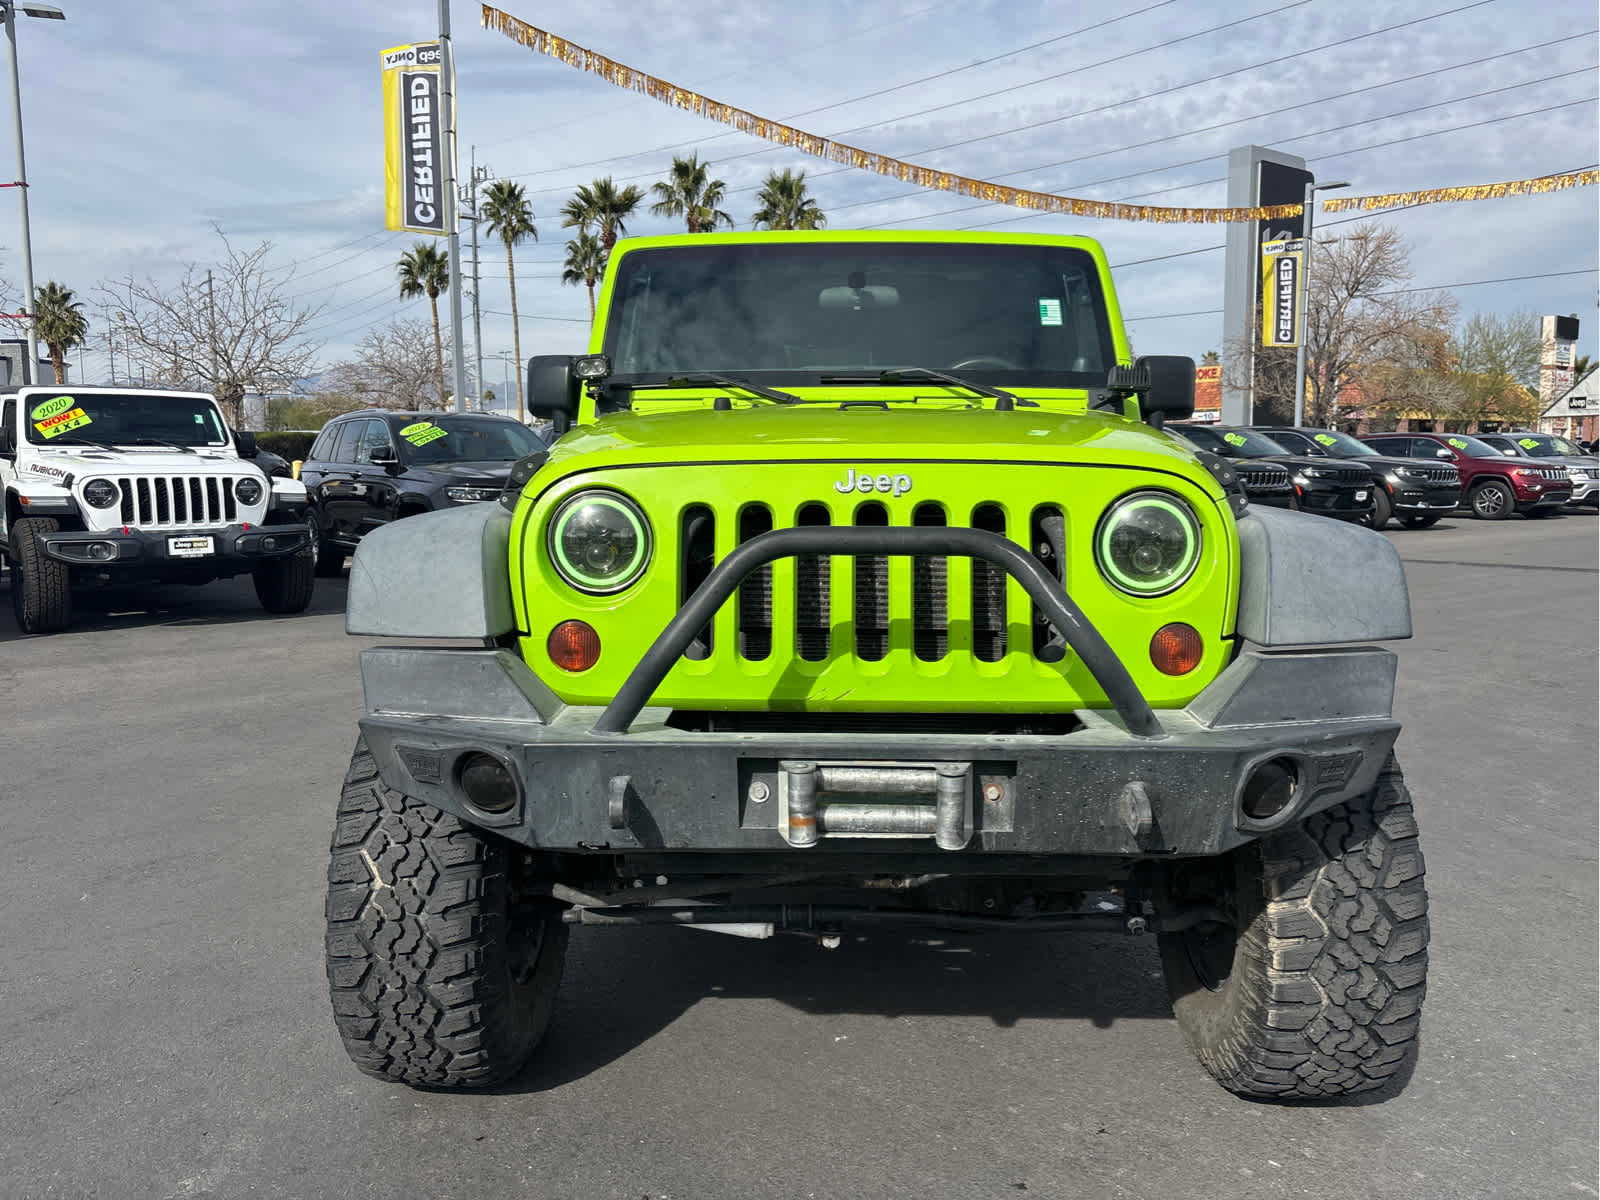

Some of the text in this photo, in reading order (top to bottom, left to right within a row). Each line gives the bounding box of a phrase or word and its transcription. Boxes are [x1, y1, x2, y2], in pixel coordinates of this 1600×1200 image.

[1196, 368, 1217, 379] OKE
[39, 398, 67, 418] 2020
[1569, 398, 1585, 407] Jeep
[41, 413, 71, 428] WOW
[30, 463, 67, 478] RUBICON
[834, 467, 914, 498] Jeep
